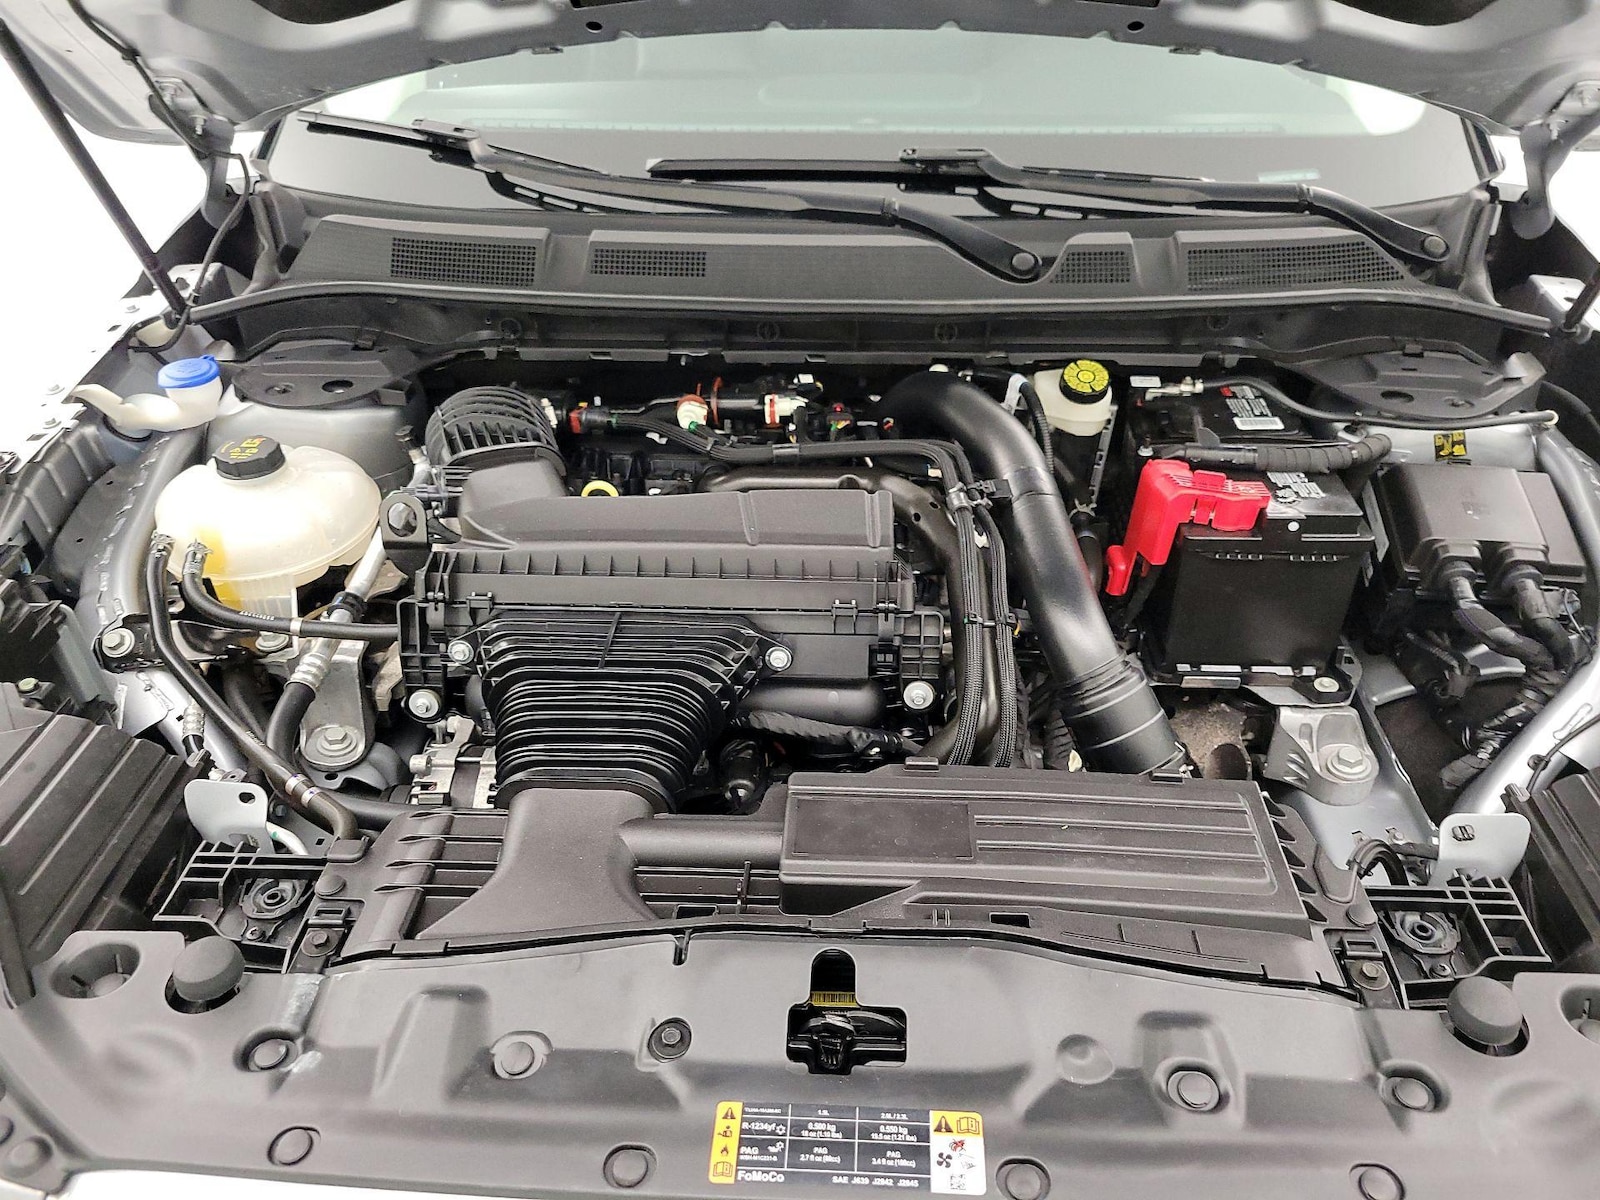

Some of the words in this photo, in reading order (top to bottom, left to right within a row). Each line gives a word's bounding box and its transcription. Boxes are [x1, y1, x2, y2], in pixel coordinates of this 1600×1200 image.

[742, 1122, 776, 1132] R-1234yf
[827, 1123, 836, 1132] kg
[899, 1126, 908, 1134] kg
[740, 1146, 758, 1154] PAG
[737, 1171, 785, 1182] FoMoCo
